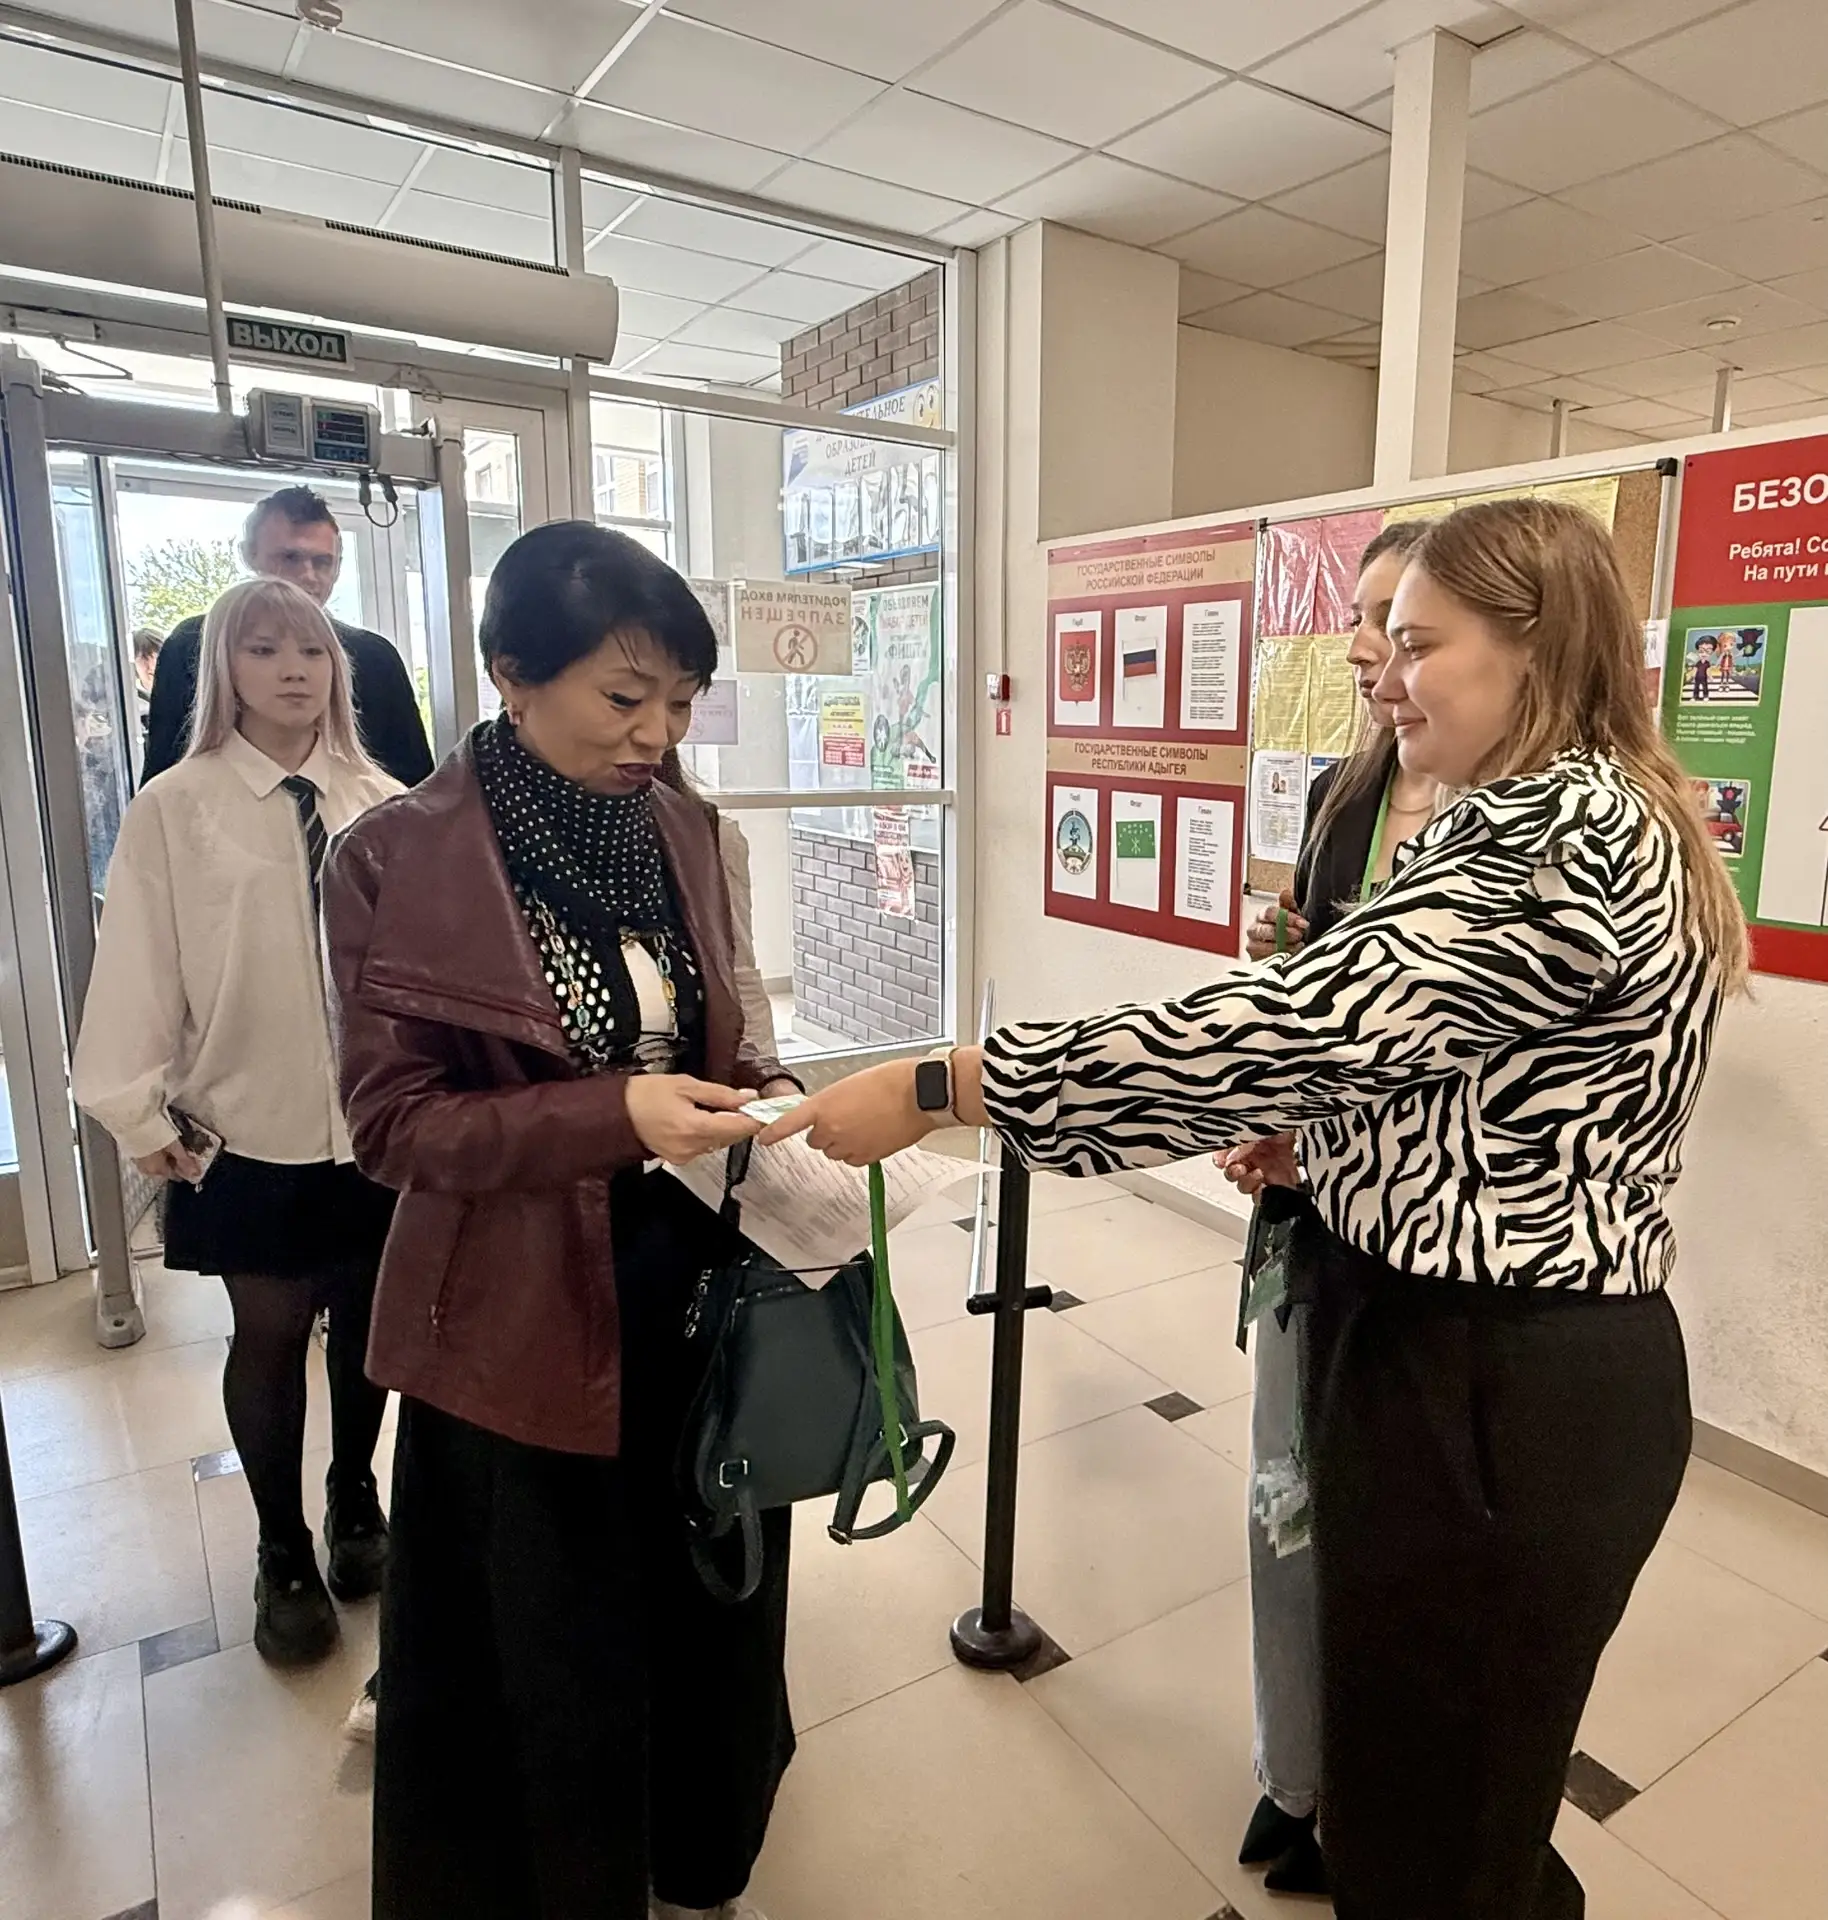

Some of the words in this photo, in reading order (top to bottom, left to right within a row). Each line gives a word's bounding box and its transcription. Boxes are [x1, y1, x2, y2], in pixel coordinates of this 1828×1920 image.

[231, 321, 343, 360] ВЫХОД
[844, 449, 876, 477] ДЕТЕЙ
[1733, 473, 1828, 513] БЕЗО
[1729, 537, 1801, 560] Ребята!
[1077, 554, 1163, 577] ГОСУДАРСТВЕННЫЕ
[1165, 549, 1216, 567] СИМВОЛЫ
[1743, 564, 1768, 582] На
[1773, 563, 1819, 583] пути
[1086, 571, 1144, 591] РОССИЙСКОЙ
[1146, 568, 1204, 586] ФЕДЕРАЦИИ
[1074, 742, 1157, 758] ГОСУДАРСТВЕННЫЕ
[1159, 746, 1208, 761] СИМВОЛЫ
[1091, 758, 1146, 773] РЕСПУБЛИКИ
[1148, 761, 1187, 776] АДЫГЕЯ
